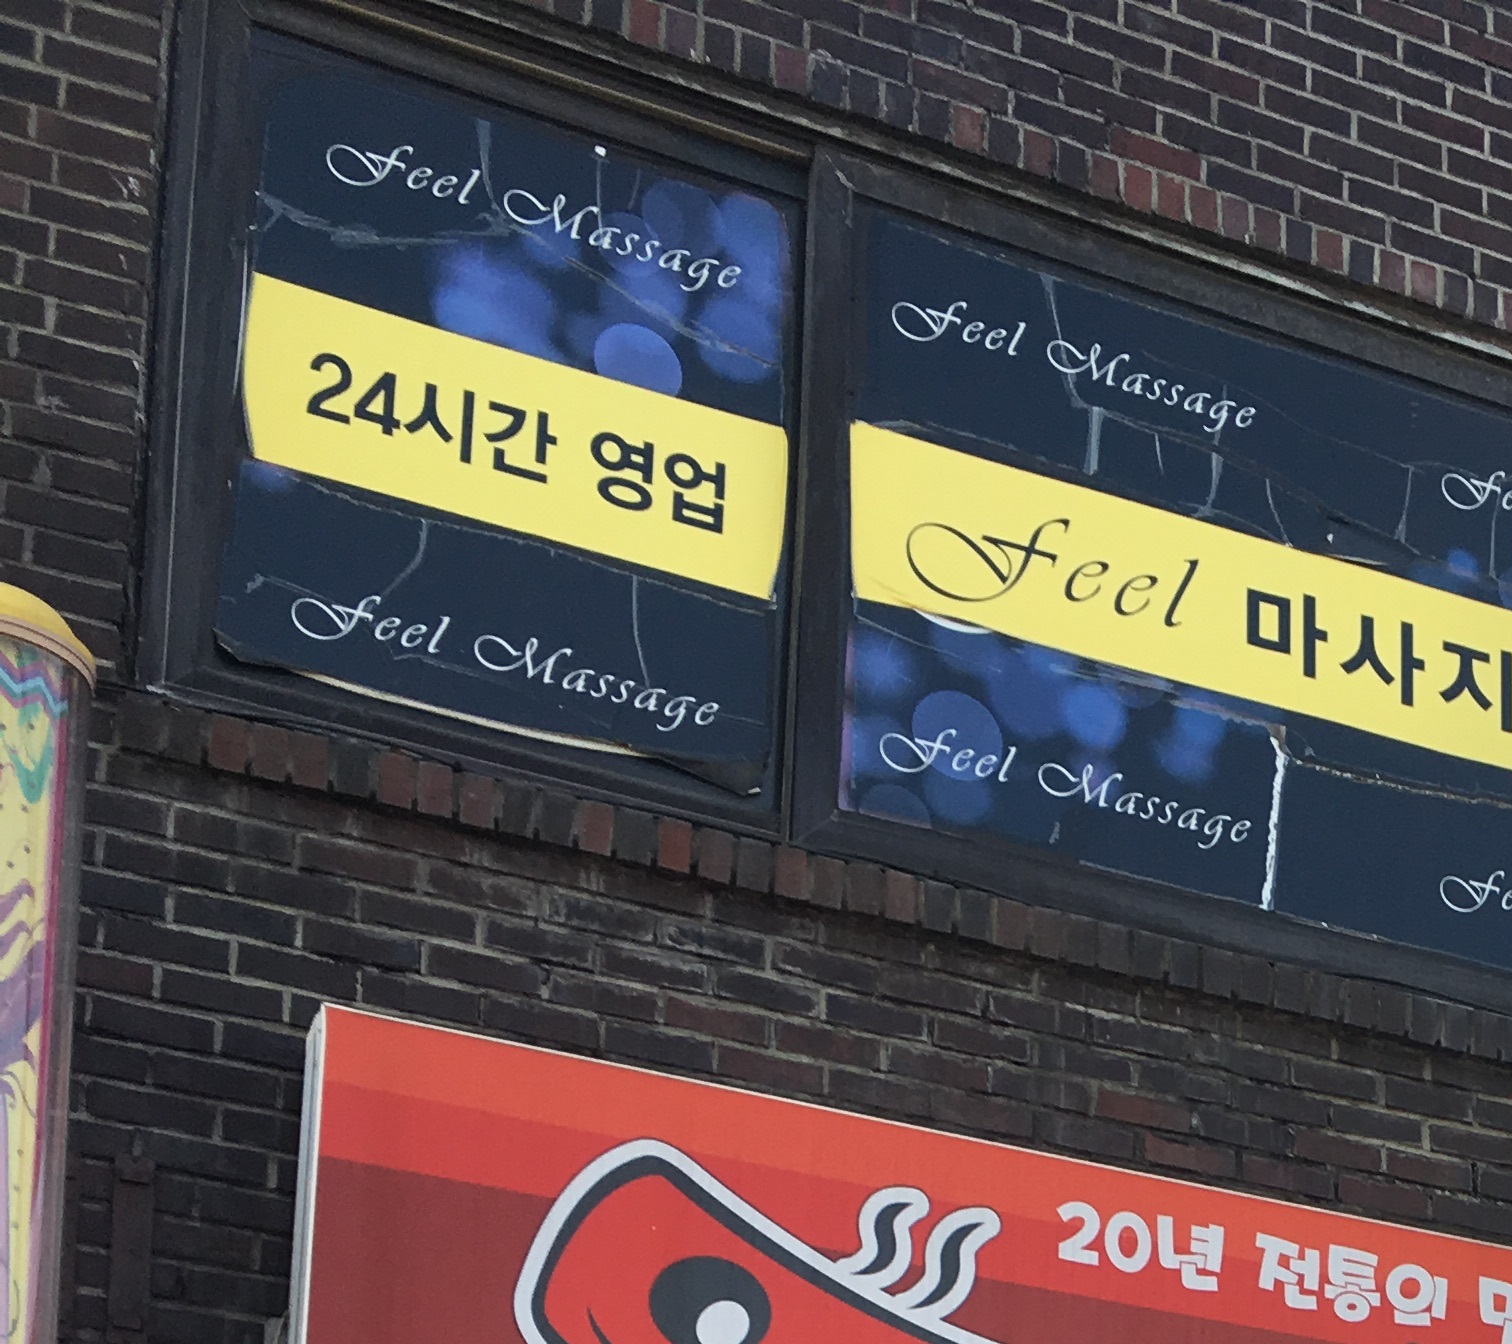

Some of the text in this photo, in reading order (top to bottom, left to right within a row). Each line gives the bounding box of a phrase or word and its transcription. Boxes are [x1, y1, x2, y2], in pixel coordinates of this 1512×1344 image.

[326, 143, 741, 291] Feel Massage
[892, 301, 1256, 432] Feel Massage
[306, 353, 727, 534] 24시간 영업
[905, 518, 1200, 628] Feel
[291, 596, 720, 731] Feel Massage
[878, 728, 1252, 849] Feel Massage
[1056, 1201, 1225, 1291] 20년
[1256, 1234, 1448, 1326] 전통의
